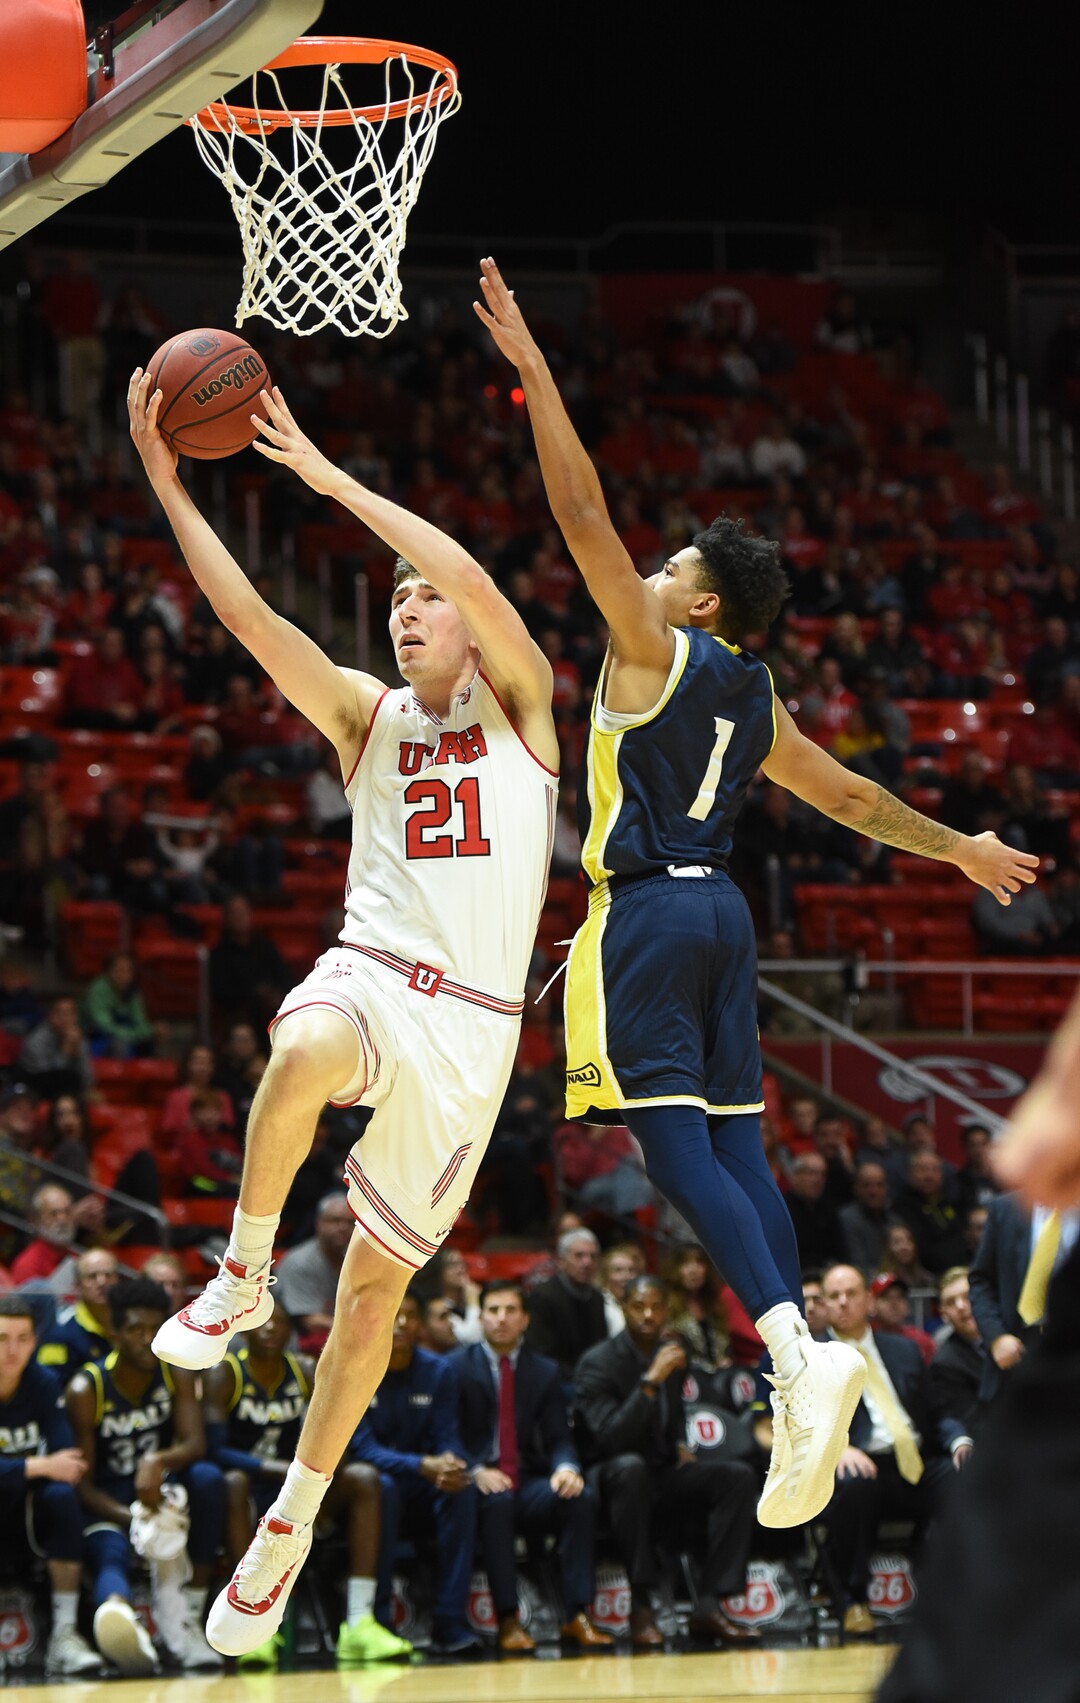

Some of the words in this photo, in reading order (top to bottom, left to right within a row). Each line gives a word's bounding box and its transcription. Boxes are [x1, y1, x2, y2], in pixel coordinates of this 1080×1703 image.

[191, 354, 263, 406] Wilson
[687, 717, 735, 821] 1
[404, 777, 491, 860] 21
[416, 967, 439, 991] U
[567, 1070, 596, 1085] NAU
[101, 1399, 171, 1438] NAU
[238, 1396, 304, 1426] NAU
[0, 1422, 40, 1453] AU
[697, 1421, 714, 1441] U
[867, 1575, 904, 1602] 66
[594, 1590, 632, 1618] 66
